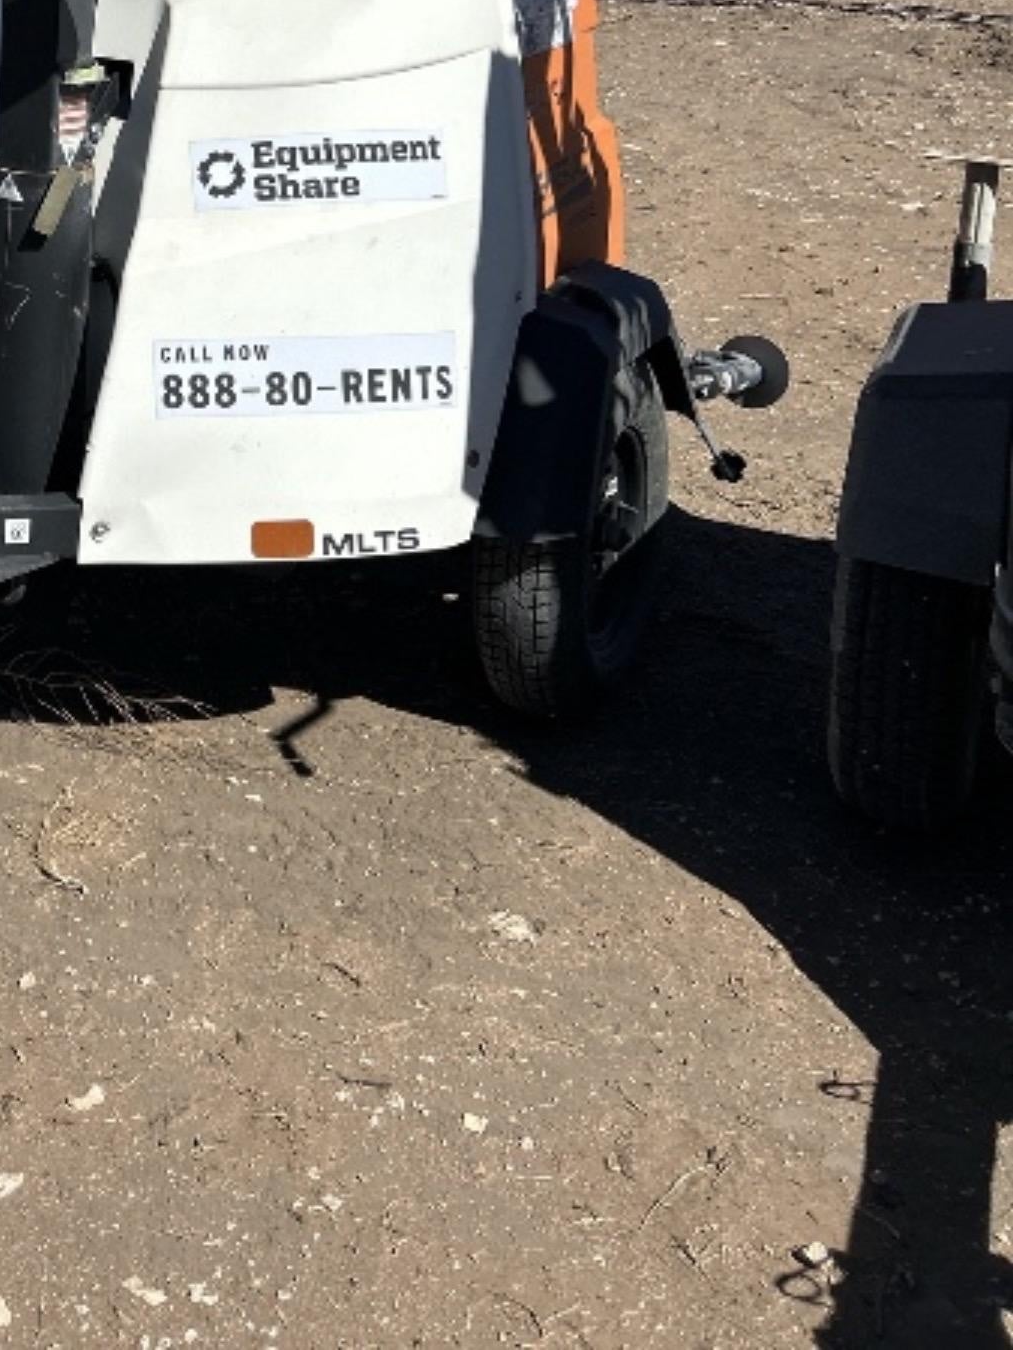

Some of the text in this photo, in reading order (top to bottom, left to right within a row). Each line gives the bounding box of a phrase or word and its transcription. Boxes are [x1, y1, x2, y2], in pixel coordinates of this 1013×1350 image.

[250, 135, 442, 172] Equipment
[252, 173, 361, 202] Share
[160, 344, 270, 363] CALL NOW
[161, 365, 454, 409] 888-80-RENTS
[321, 526, 421, 556] MLTS
